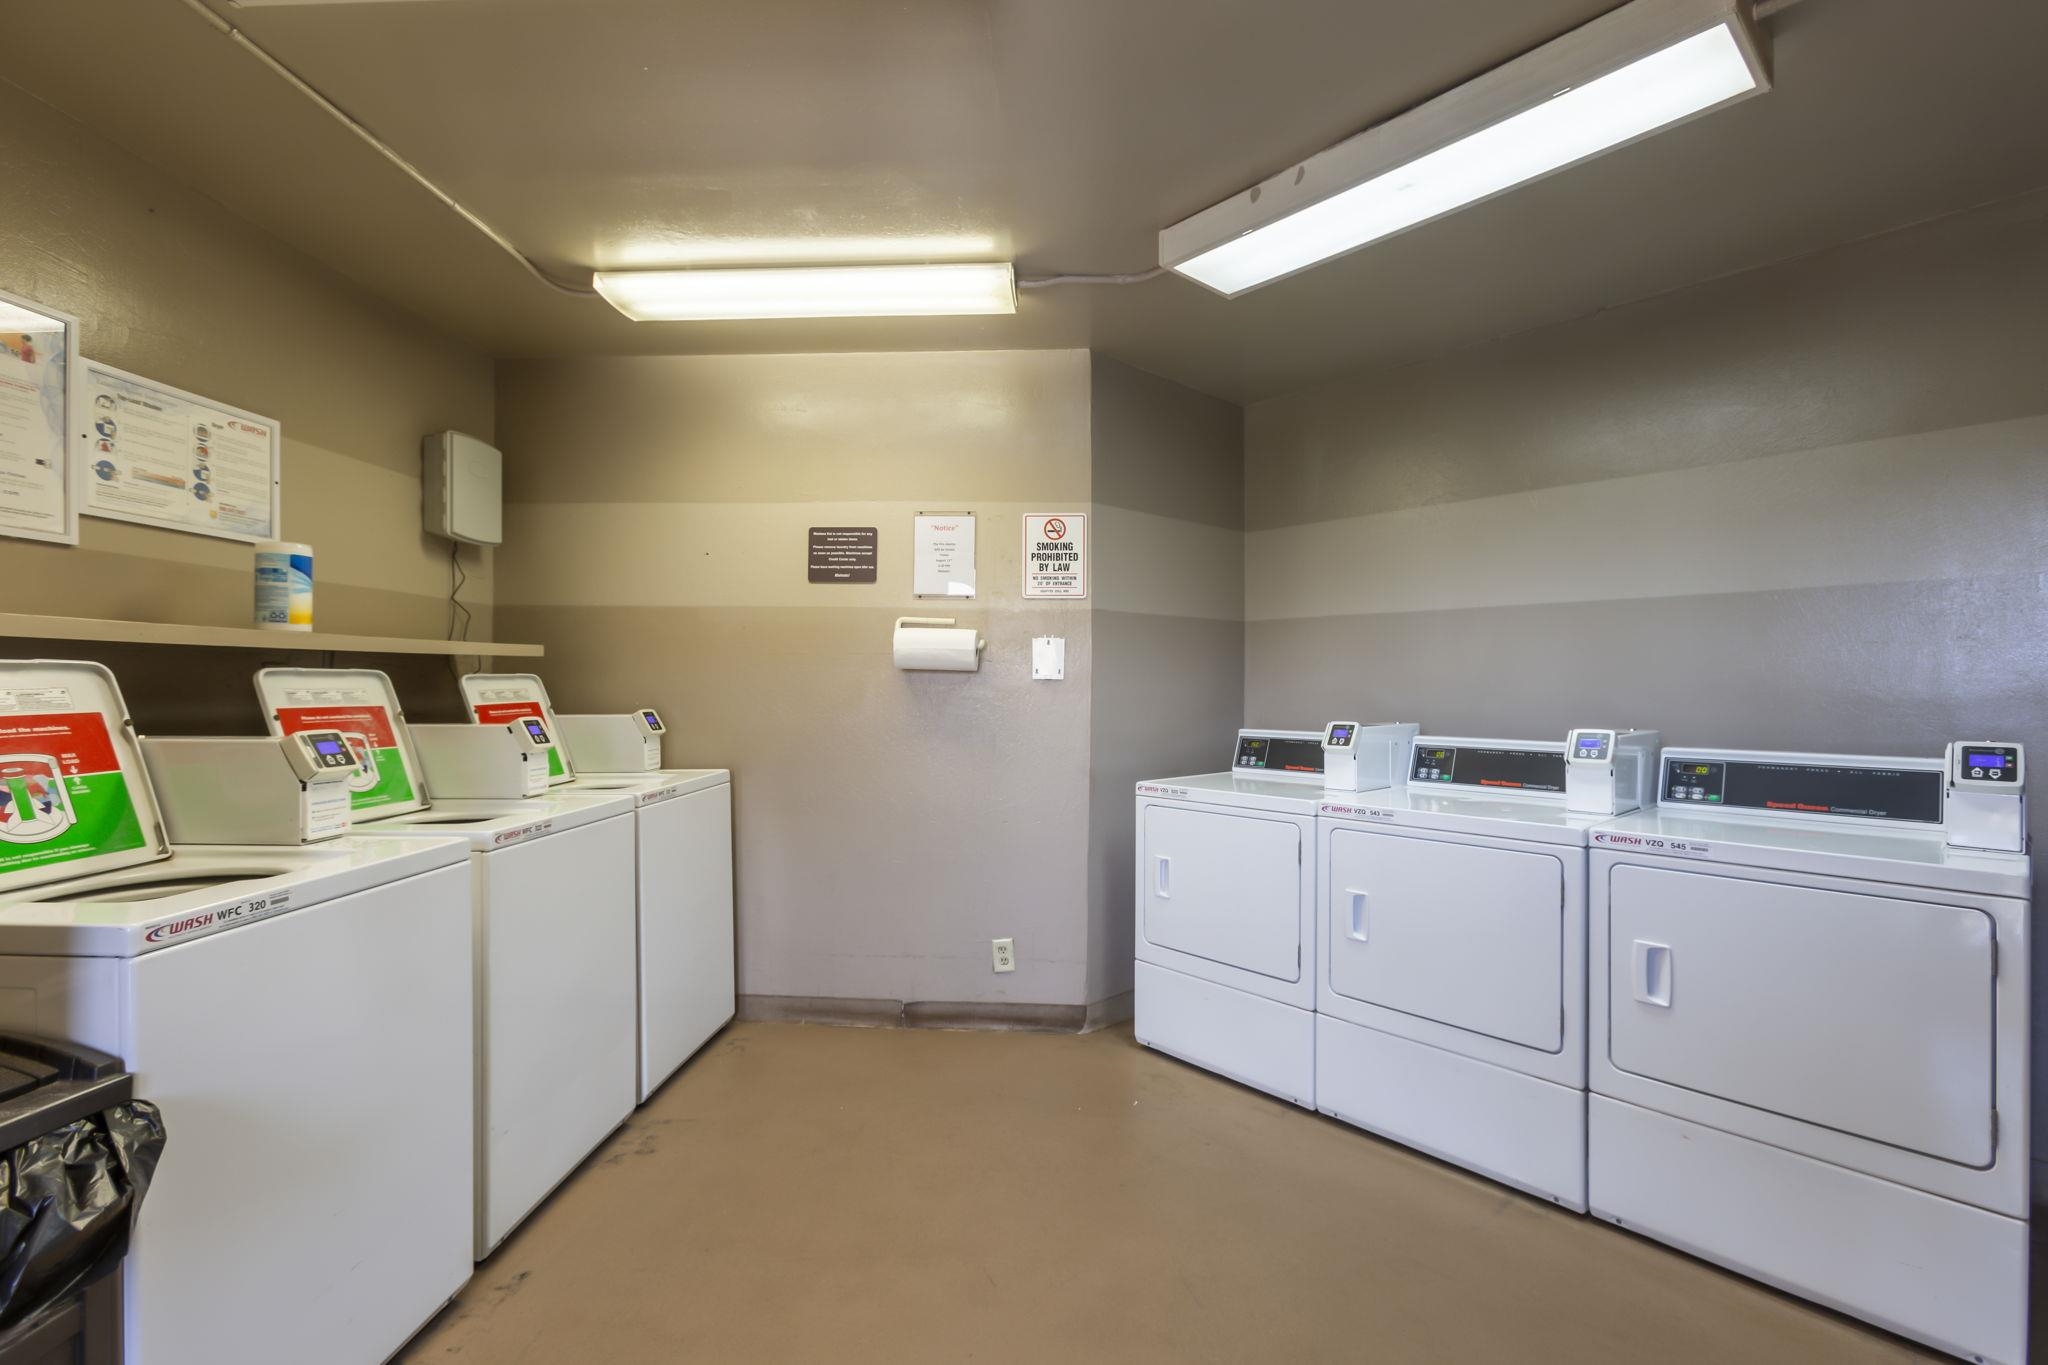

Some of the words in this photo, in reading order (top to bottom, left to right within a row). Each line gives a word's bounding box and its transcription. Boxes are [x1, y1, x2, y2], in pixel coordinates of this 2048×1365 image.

[1036, 542, 1074, 551] SMOKING
[1031, 552, 1079, 561] PROHIBITED
[1039, 563, 1049, 572] BY
[1053, 563, 1070, 572] LAW
[1331, 806, 1352, 814] WASH
[1830, 806, 1867, 815] Commercial
[1869, 809, 1887, 817] Dryer
[1610, 834, 1642, 845] WASH
[1645, 839, 1664, 848] VZQ
[1671, 842, 1687, 850] 545
[169, 913, 214, 935] WASH
[217, 905, 243, 921] WFC
[248, 899, 267, 912] 320
